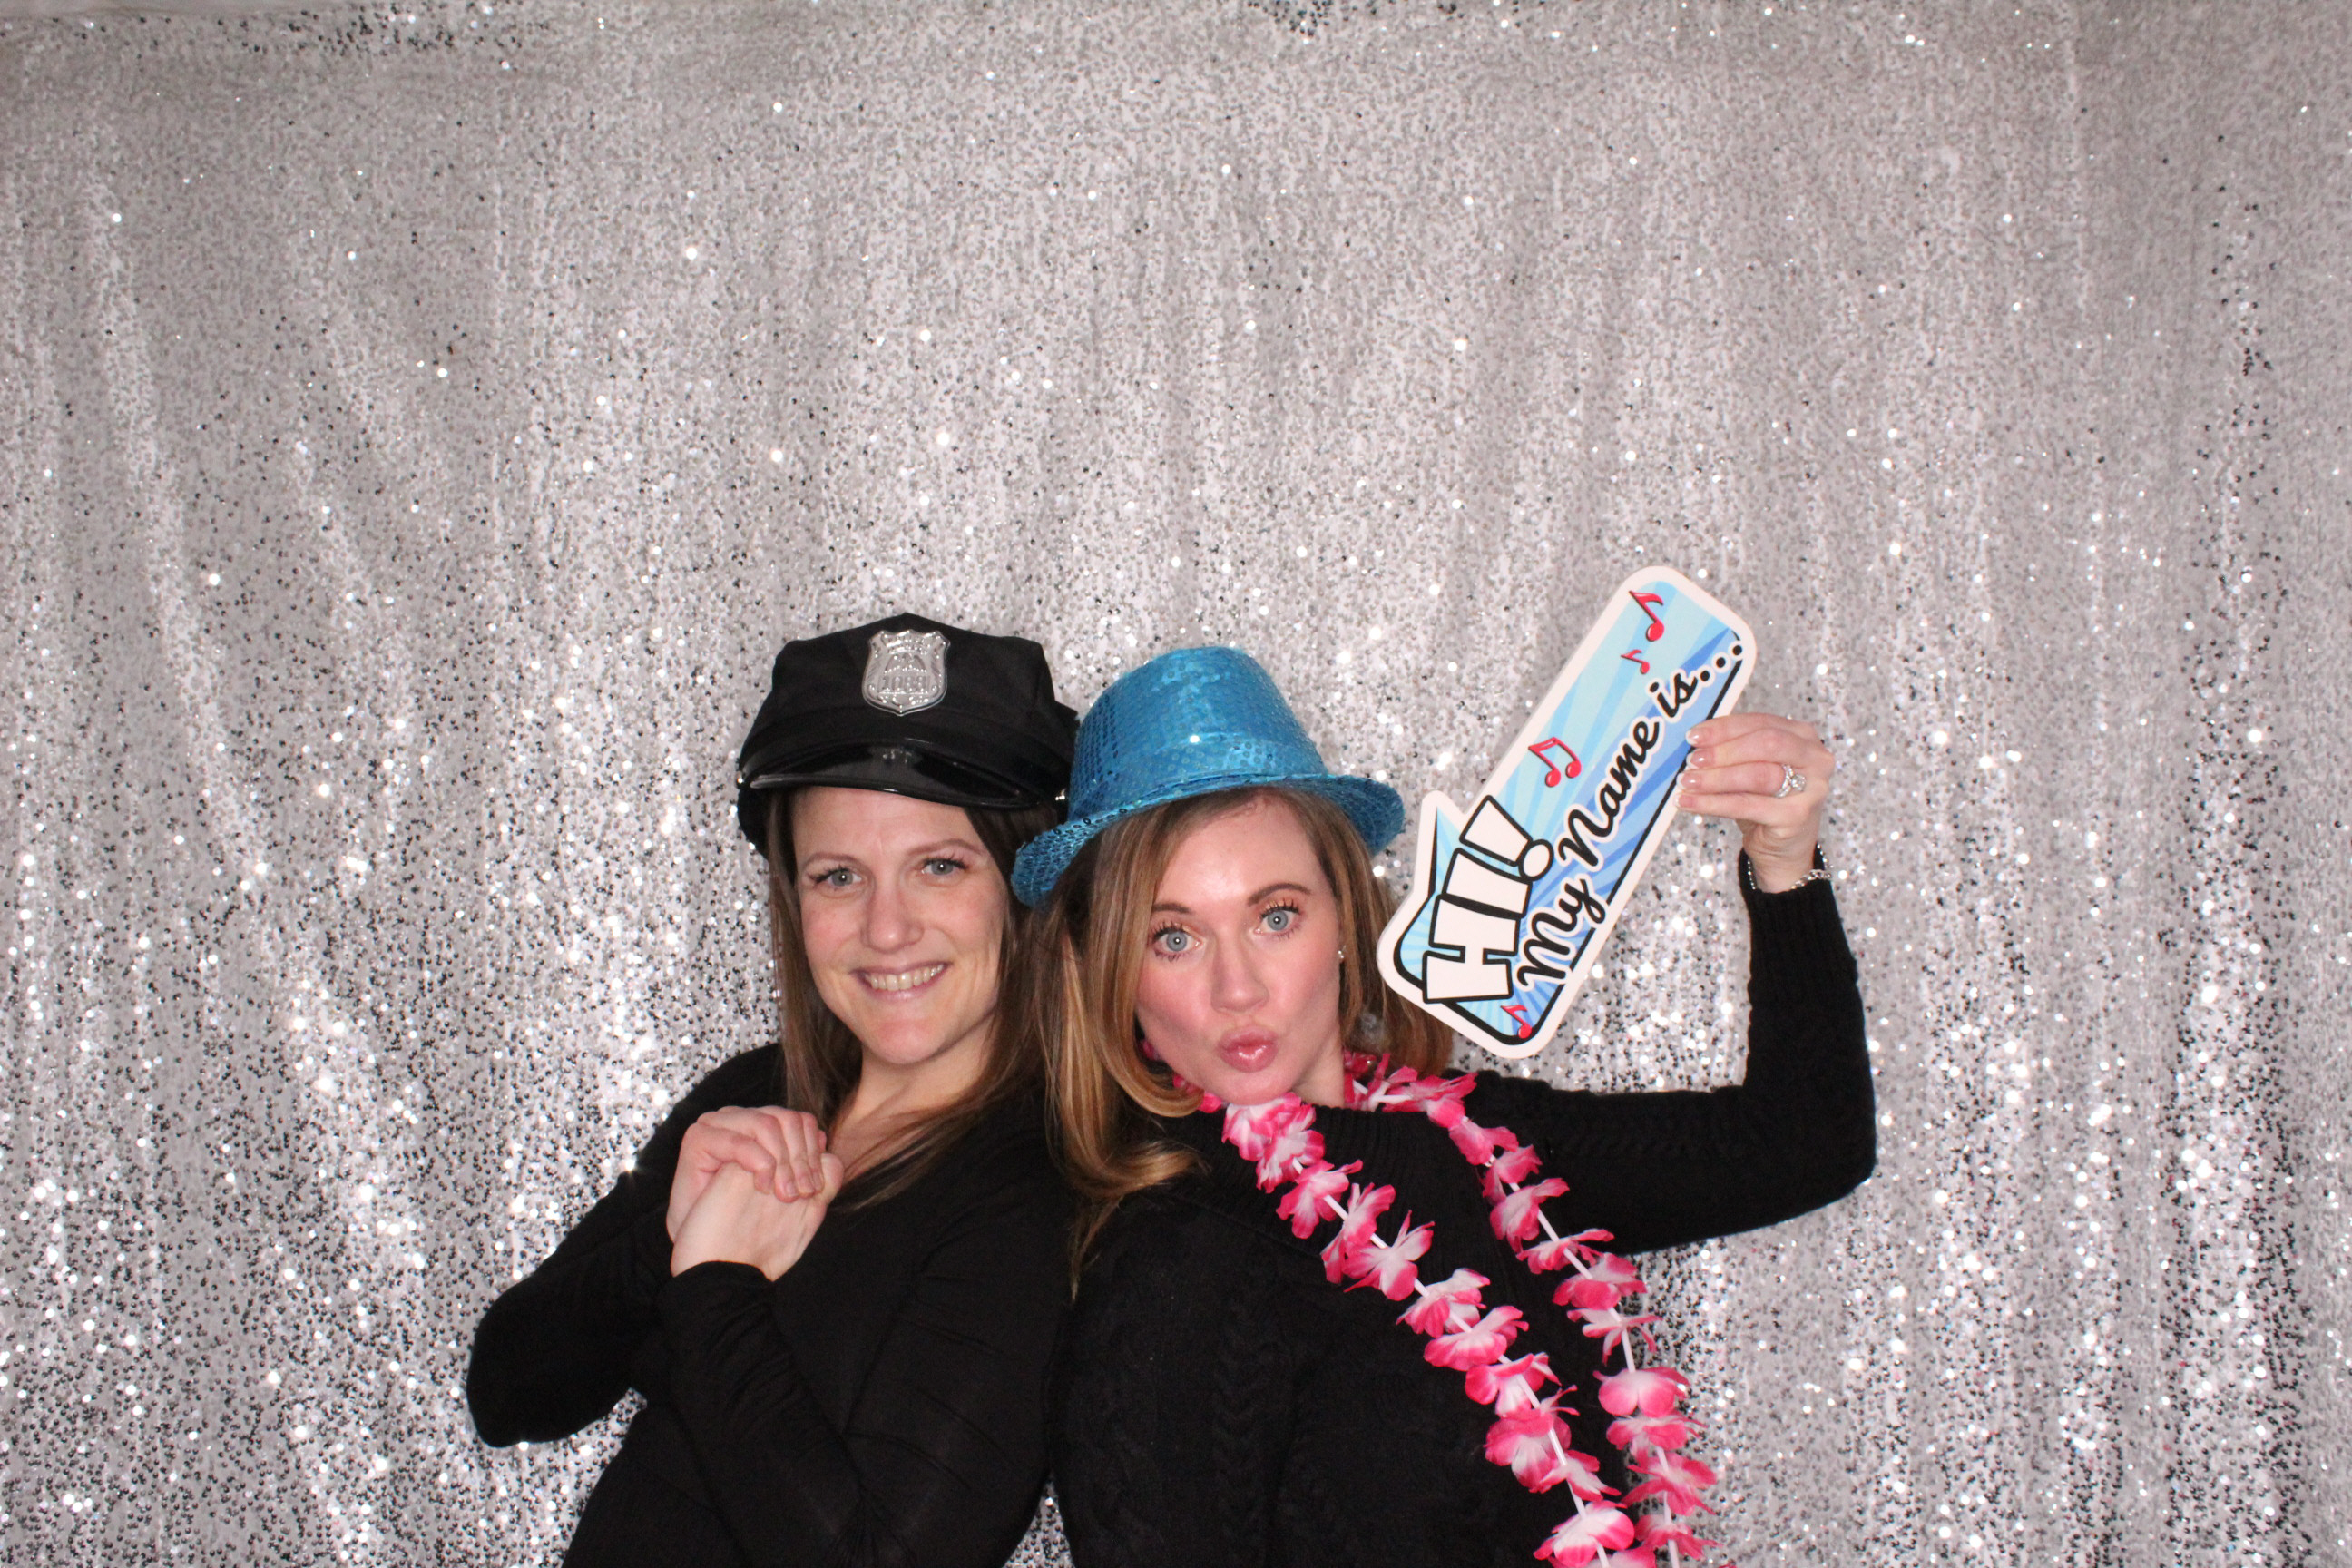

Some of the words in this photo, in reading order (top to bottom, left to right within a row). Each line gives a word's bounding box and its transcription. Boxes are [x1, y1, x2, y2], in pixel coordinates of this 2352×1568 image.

[1650, 642, 1743, 718] is...
[1558, 721, 1660, 867] Name
[1421, 795, 1554, 1004] HI!
[1518, 879, 1606, 986] My
